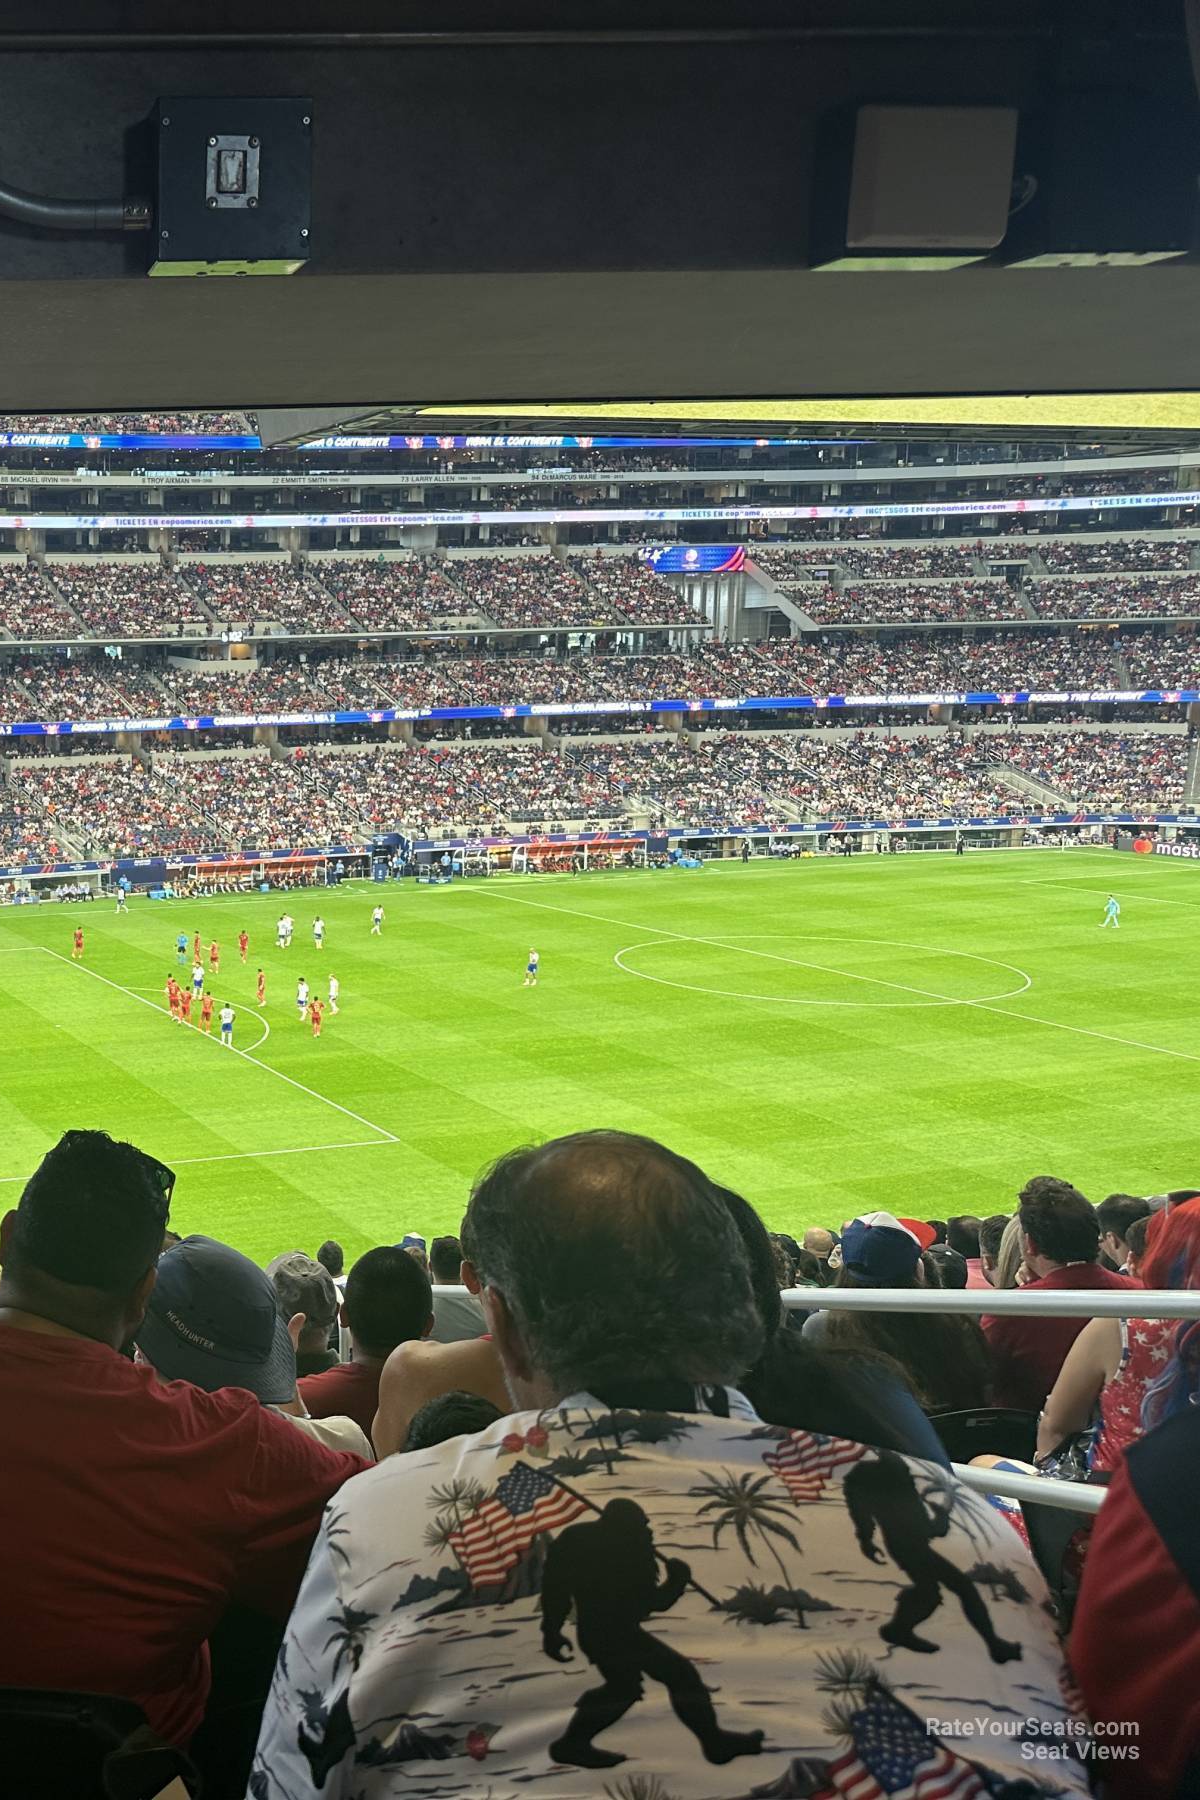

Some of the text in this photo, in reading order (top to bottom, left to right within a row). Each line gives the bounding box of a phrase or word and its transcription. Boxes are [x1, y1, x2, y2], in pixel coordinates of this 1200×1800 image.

[11, 434, 70, 446] CONTINENTE
[115, 518, 146, 526] TICKETS
[160, 518, 232, 527] copaamerica.com
[393, 515, 464, 524] copaameica.com
[1156, 843, 1200, 858] mast
[166, 1310, 215, 1350] HEADHUNTER
